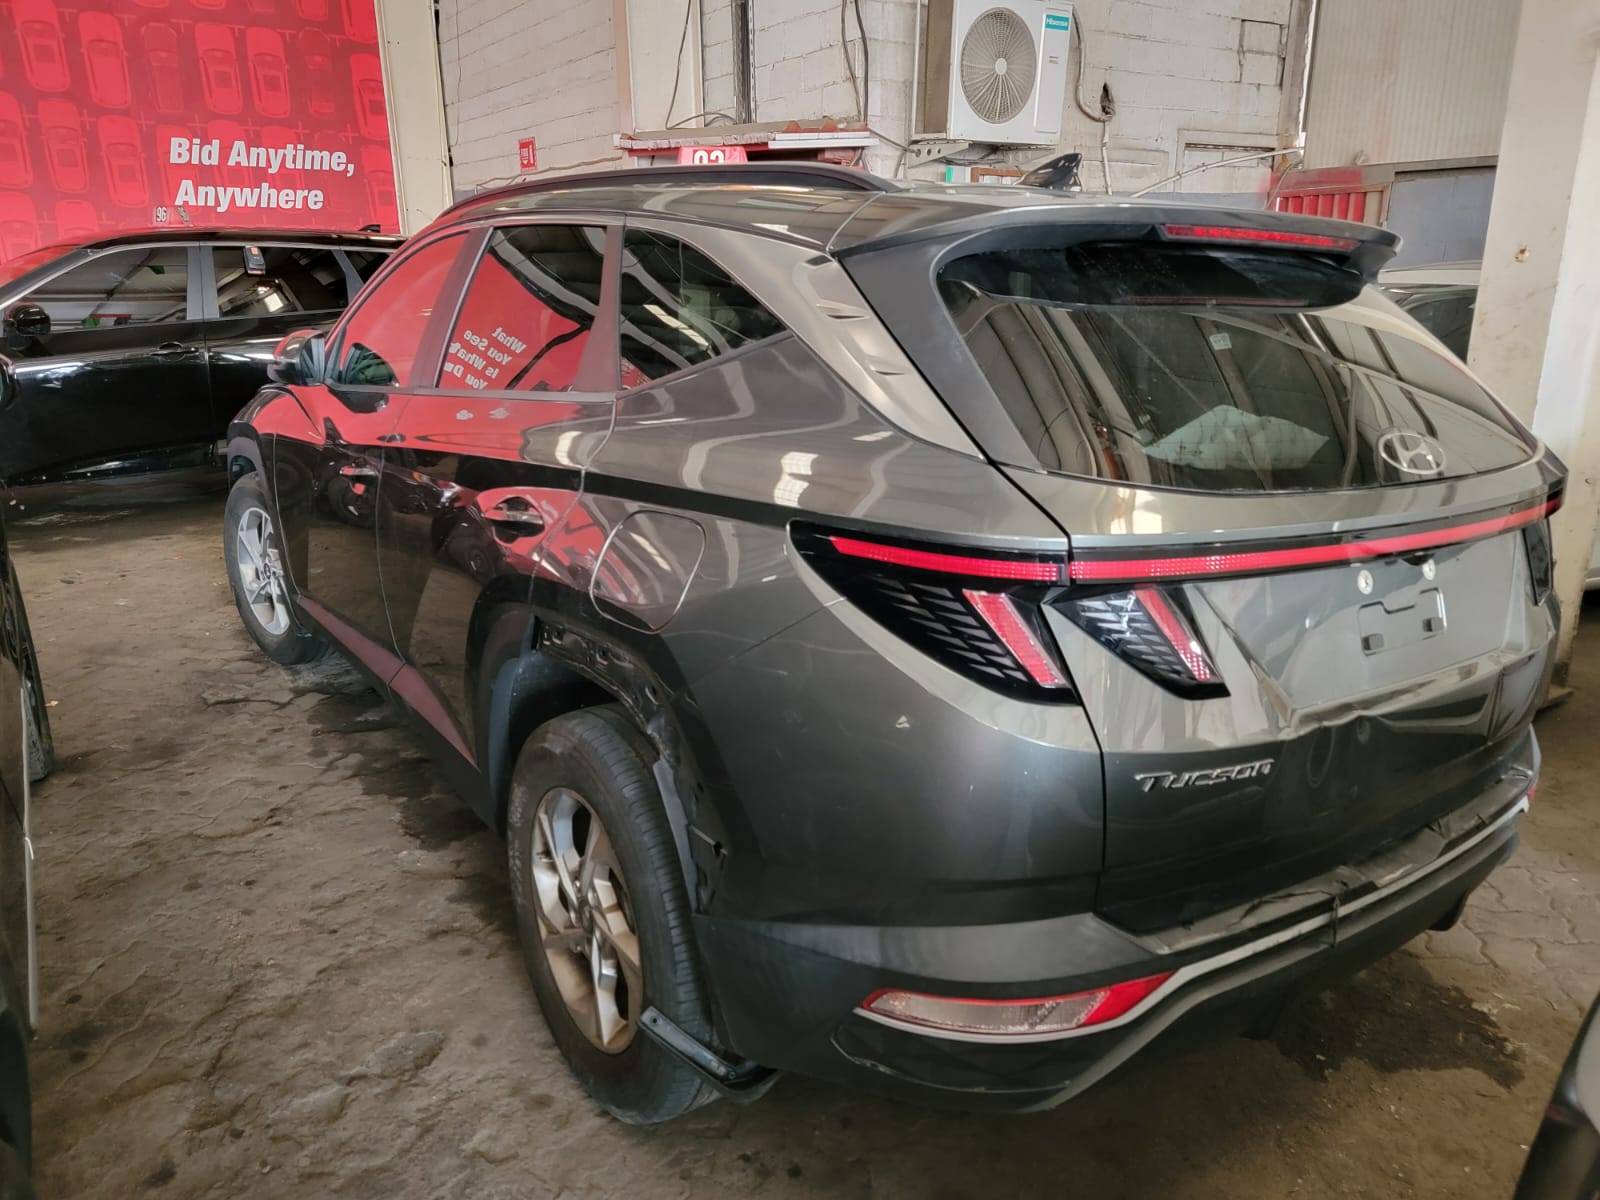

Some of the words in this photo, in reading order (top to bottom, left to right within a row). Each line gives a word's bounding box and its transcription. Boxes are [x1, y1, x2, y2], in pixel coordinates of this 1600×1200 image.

[170, 137, 220, 166] Bid
[227, 140, 355, 177] Anytime,
[174, 179, 325, 213] Anywhere
[1134, 758, 1275, 792] TUCSON
